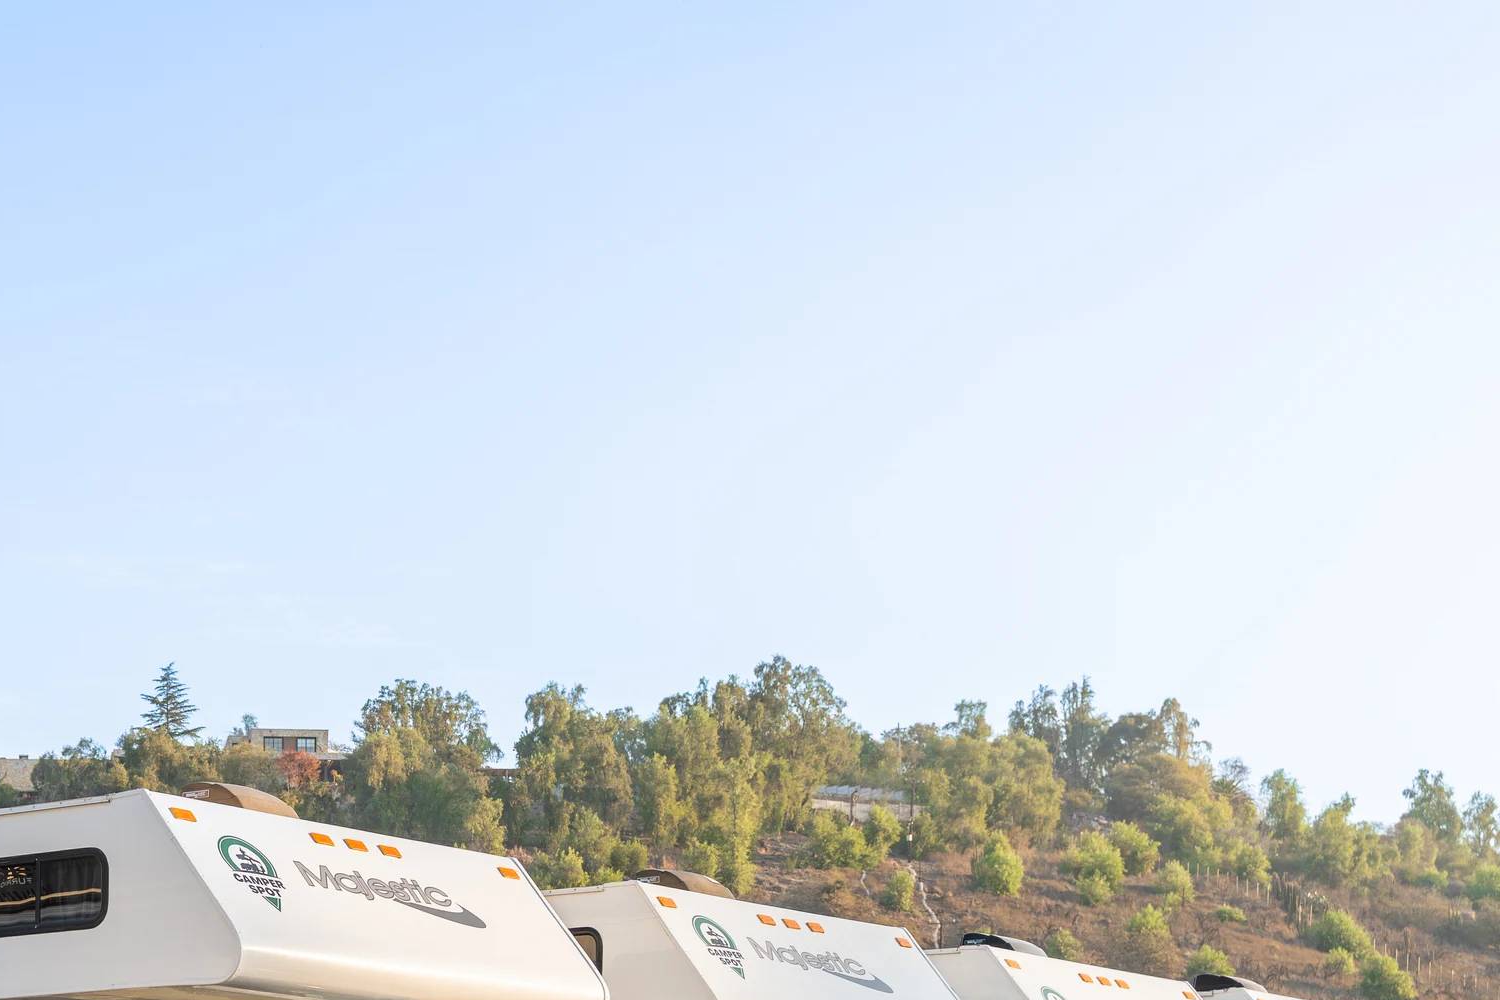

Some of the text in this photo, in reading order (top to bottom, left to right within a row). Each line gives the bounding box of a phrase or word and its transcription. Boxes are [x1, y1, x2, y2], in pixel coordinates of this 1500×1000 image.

[233, 873, 286, 890] CAMPER
[293, 860, 452, 907] Majestic
[249, 884, 282, 898] SPOT
[708, 948, 744, 960] CAMPER
[747, 937, 866, 976] Majestic
[719, 957, 743, 967] SPOT
